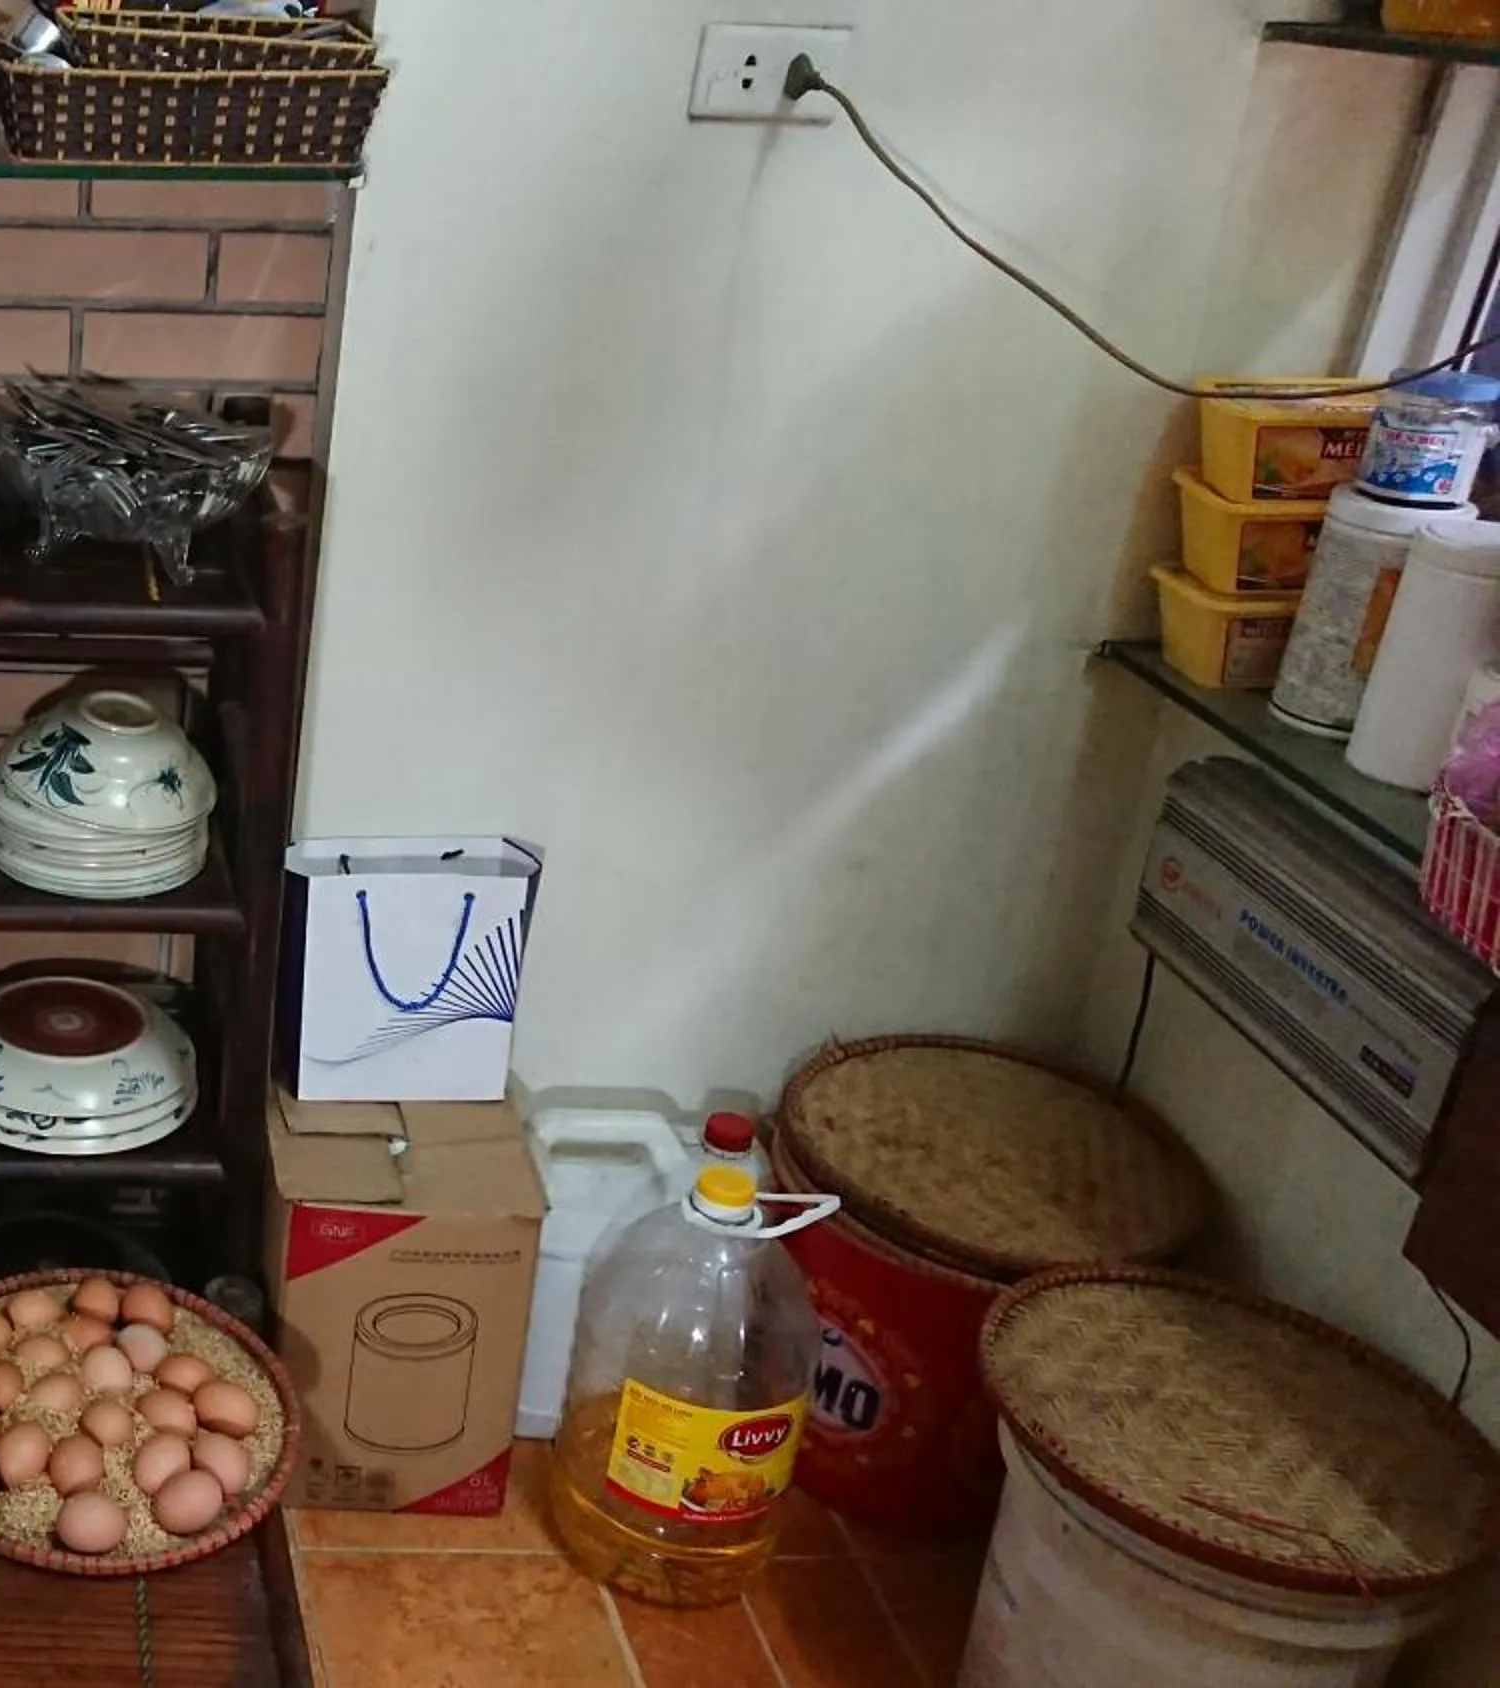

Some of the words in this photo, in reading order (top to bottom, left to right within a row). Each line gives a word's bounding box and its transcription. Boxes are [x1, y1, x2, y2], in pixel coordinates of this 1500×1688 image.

[1324, 441, 1362, 457] MEI
[813, 1360, 880, 1431] MO
[732, 1424, 788, 1447] Livvy
